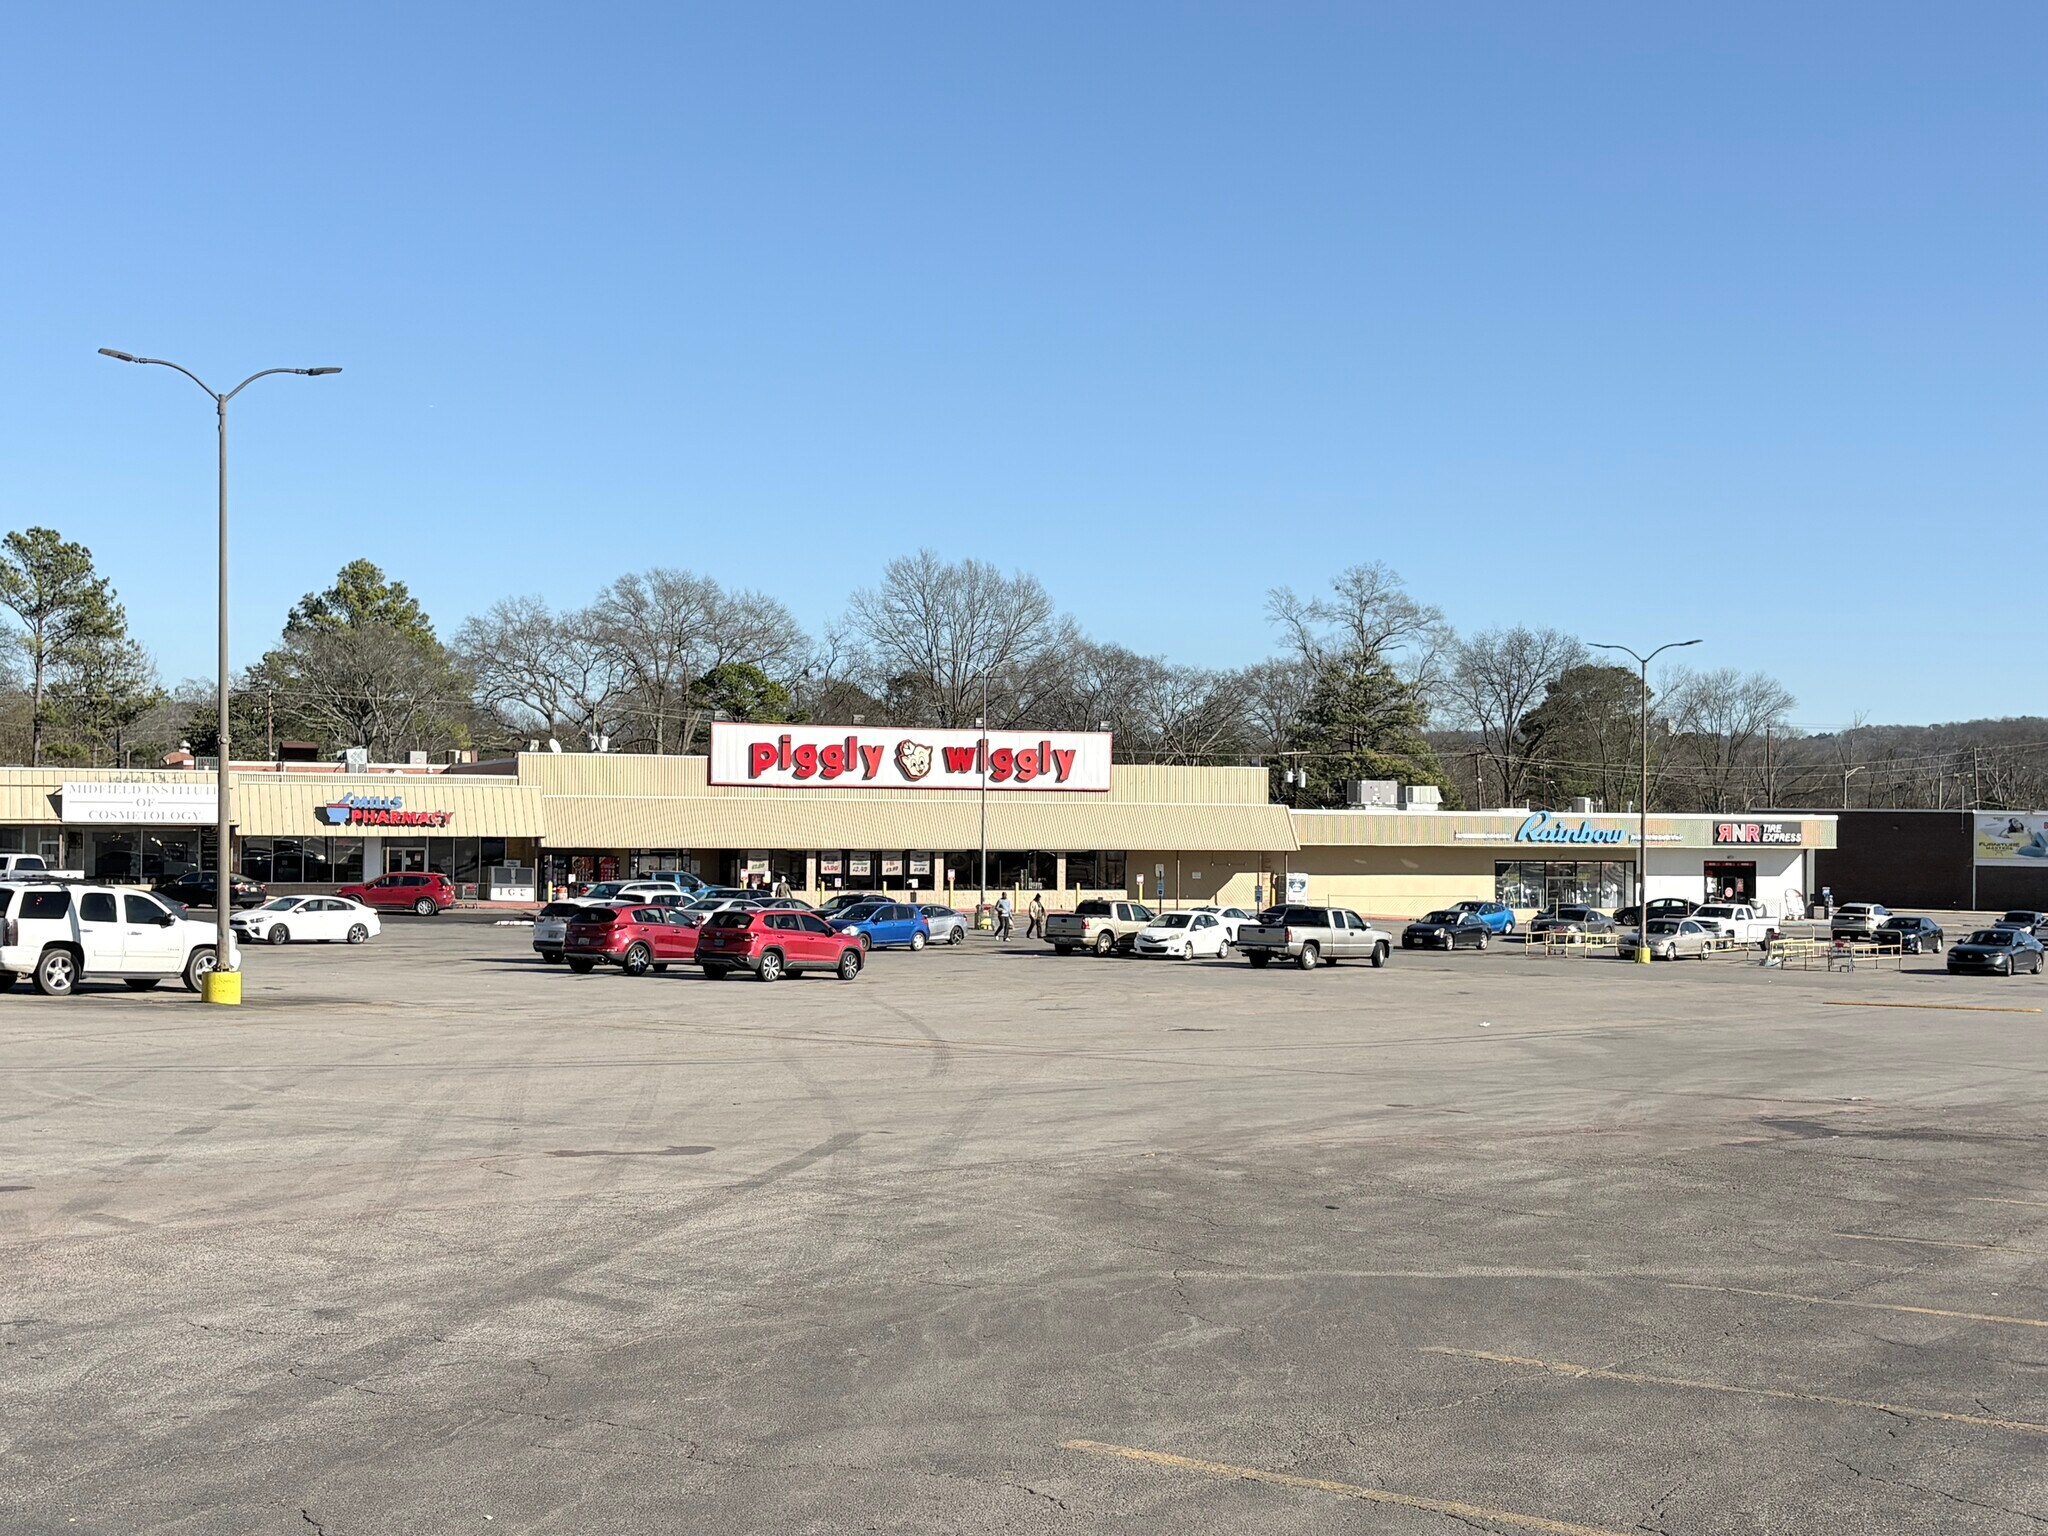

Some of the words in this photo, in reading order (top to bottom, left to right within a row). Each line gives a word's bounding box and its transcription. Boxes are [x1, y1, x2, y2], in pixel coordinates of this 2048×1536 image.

[748, 734, 885, 781] piggly
[942, 738, 1077, 783] wiggly
[69, 784, 141, 794] MIDFIELD
[136, 798, 155, 808] OF
[352, 796, 403, 810] MILLS
[88, 810, 202, 820] COSMETOLOGY
[351, 809, 454, 825] PHARMACY
[1514, 809, 1627, 844] Rainbow
[1762, 824, 1783, 833] TIRE
[1717, 823, 1760, 843] RNR
[1762, 833, 1802, 843] EXPRESS
